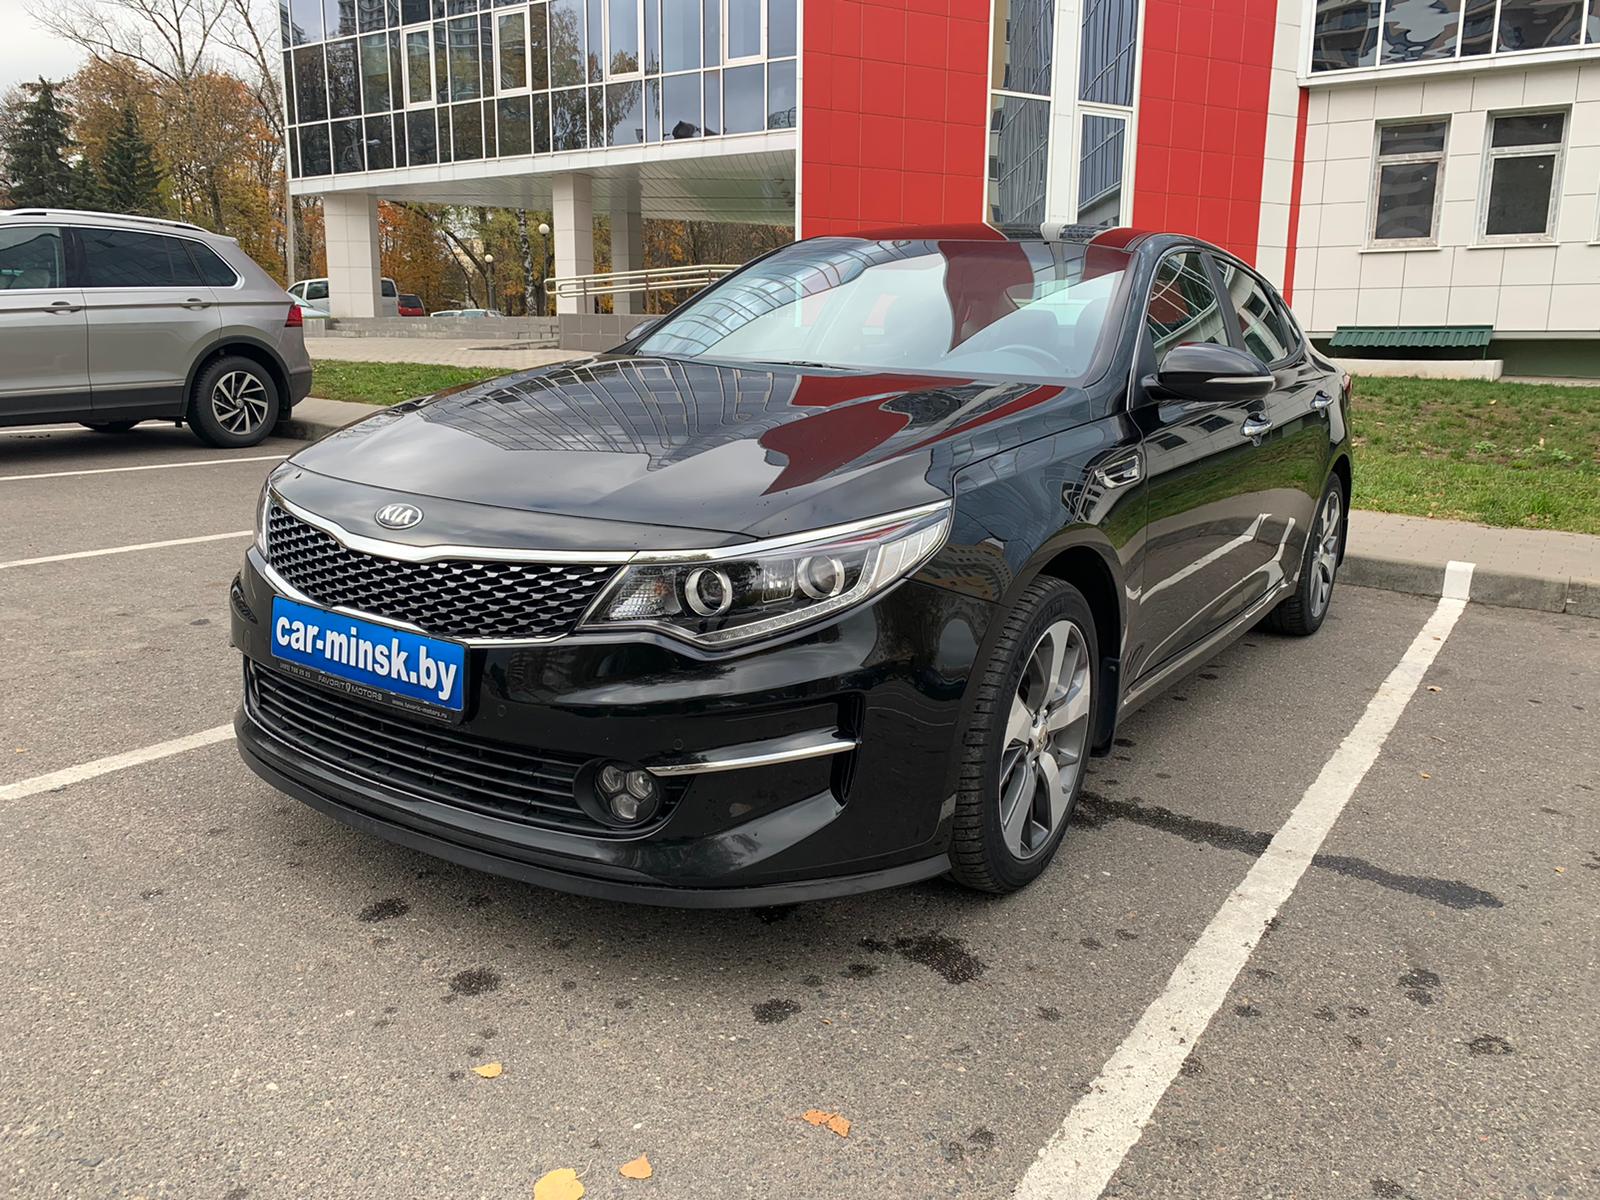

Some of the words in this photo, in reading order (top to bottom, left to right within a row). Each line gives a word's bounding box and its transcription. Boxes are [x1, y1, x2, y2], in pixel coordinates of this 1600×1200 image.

[380, 505, 413, 524] KIA
[276, 616, 457, 701] car-minsk.by
[318, 675, 345, 690] FAVORIT
[351, 685, 383, 701] MOTORS
